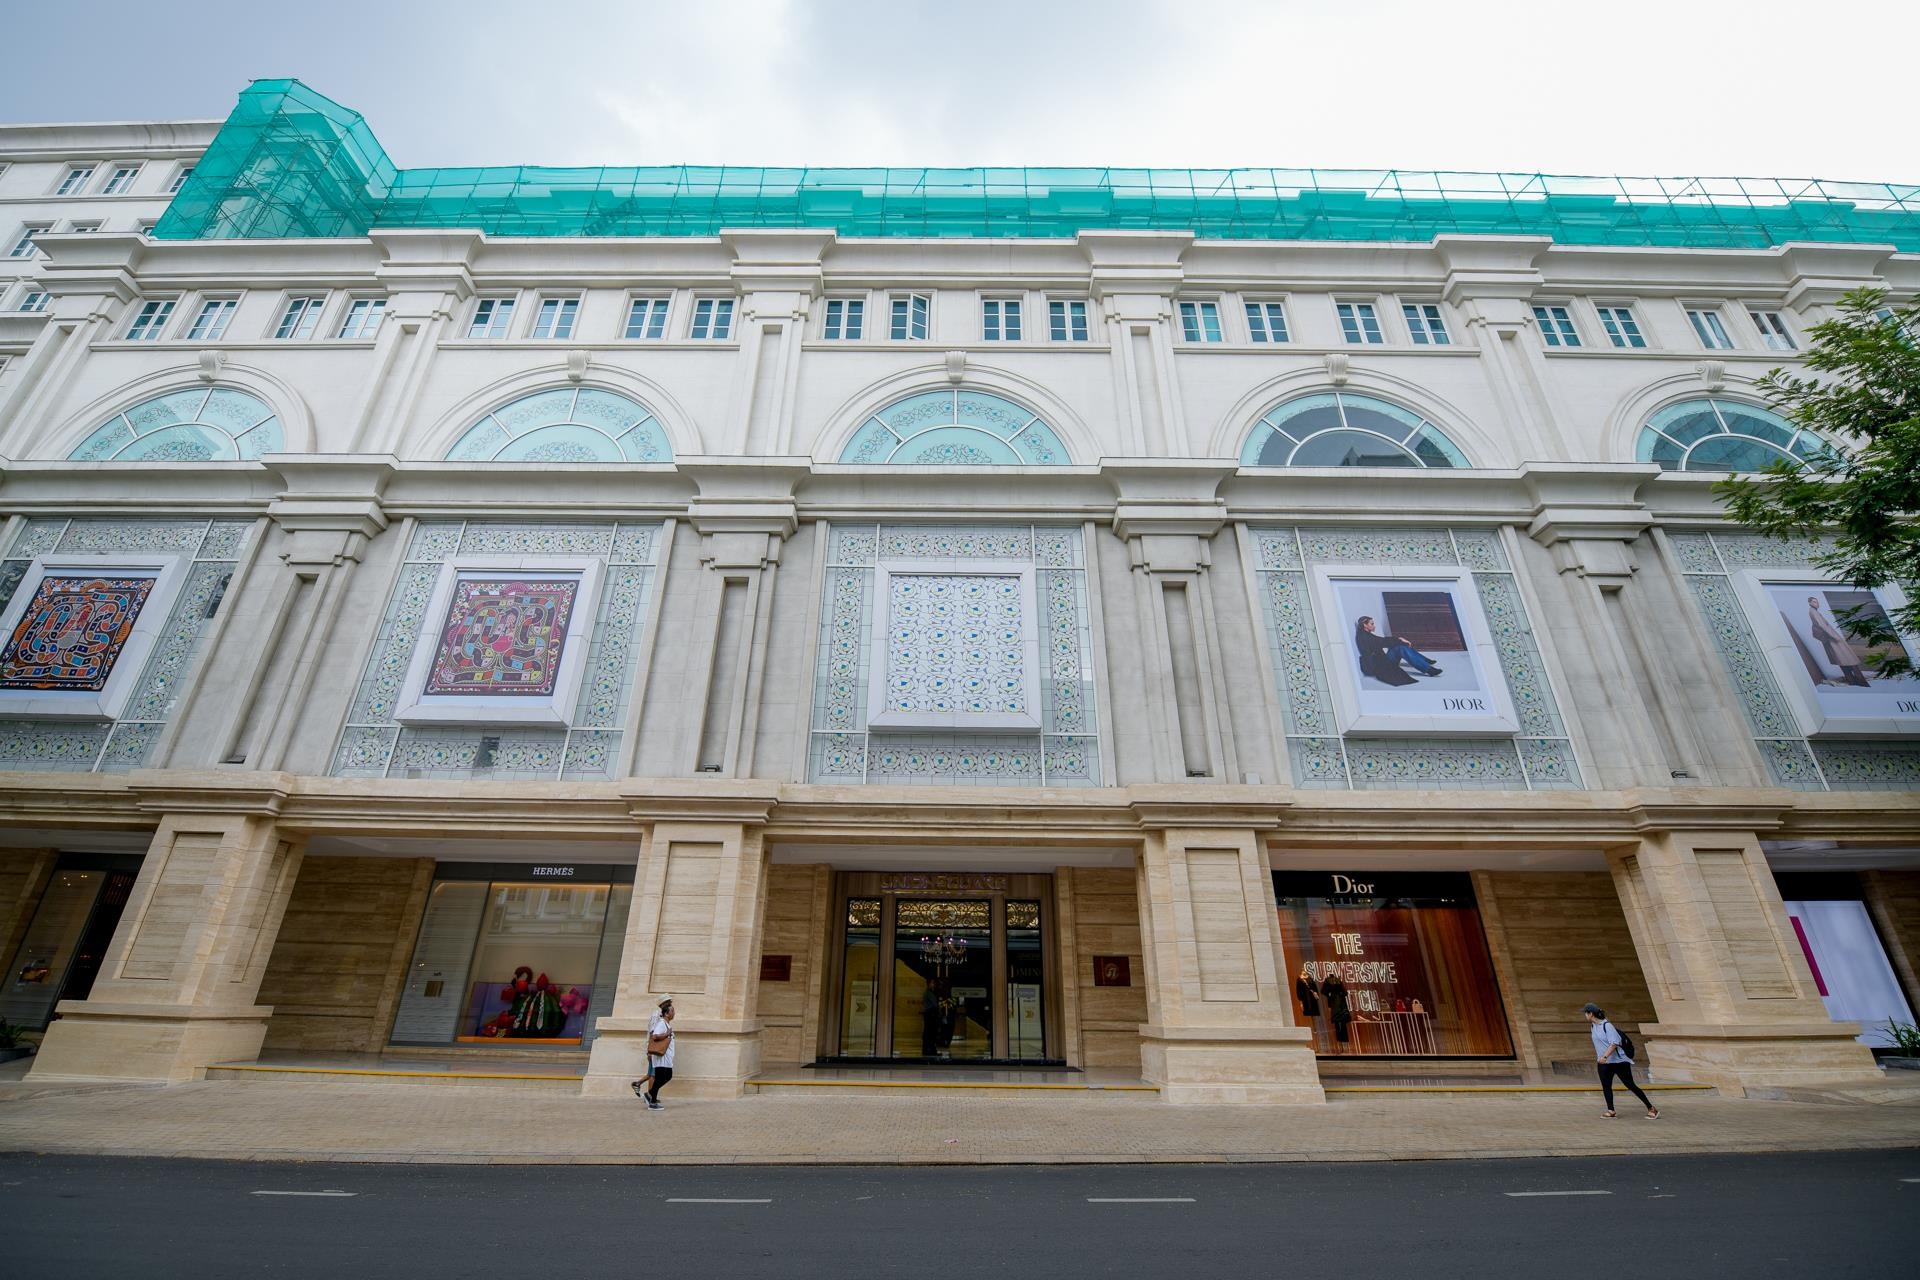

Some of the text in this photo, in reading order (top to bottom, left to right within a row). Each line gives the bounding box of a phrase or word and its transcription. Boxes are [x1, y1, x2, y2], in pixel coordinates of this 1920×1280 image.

[1443, 698, 1488, 711] DIOR
[1331, 875, 1375, 894] Dior
[1331, 933, 1364, 955] THE
